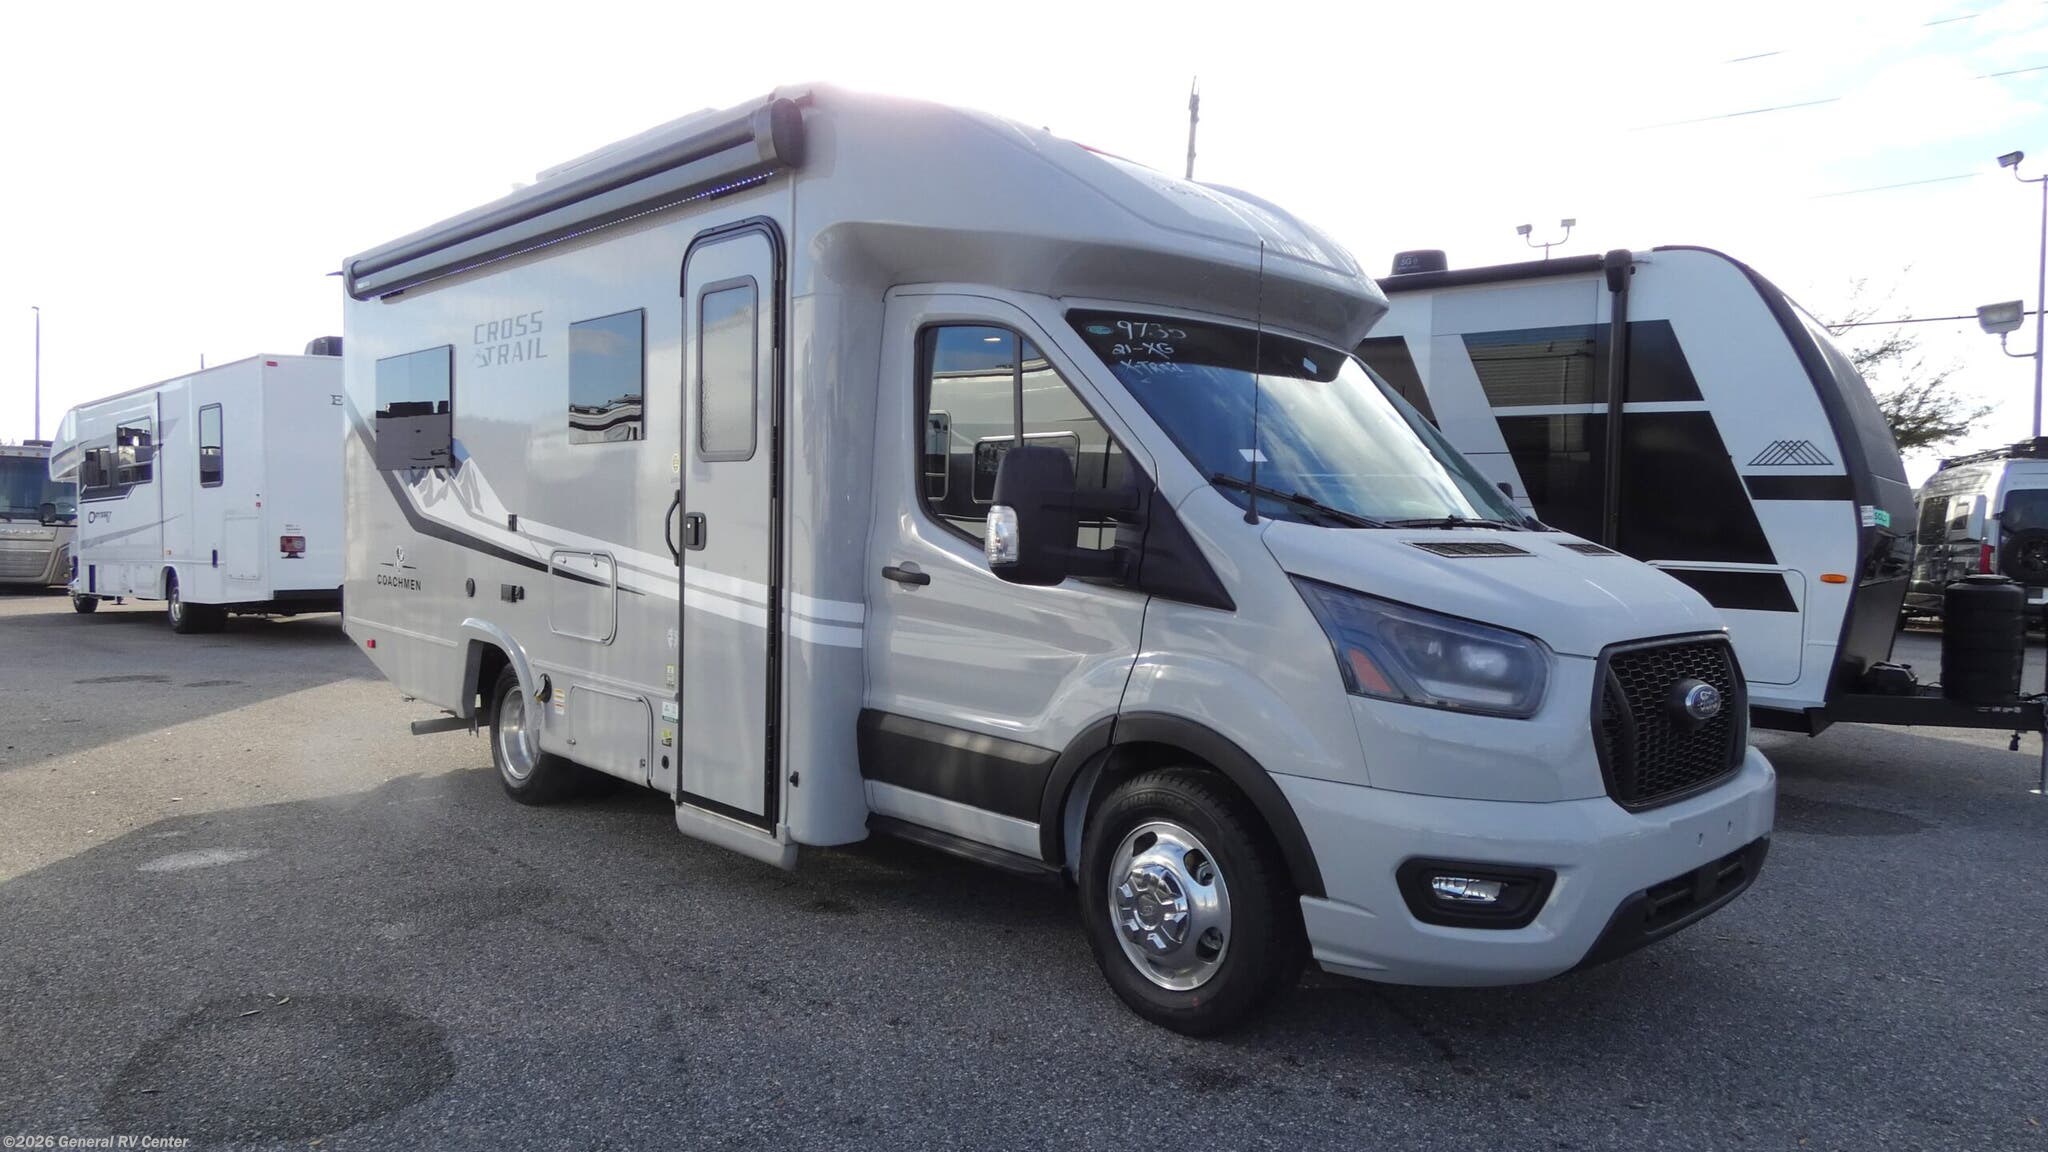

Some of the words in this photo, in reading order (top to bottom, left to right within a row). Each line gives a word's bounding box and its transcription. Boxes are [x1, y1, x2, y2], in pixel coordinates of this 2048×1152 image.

[474, 310, 543, 345] CROSS
[485, 337, 548, 366] TRAIL
[377, 574, 421, 591] COACHMEN
